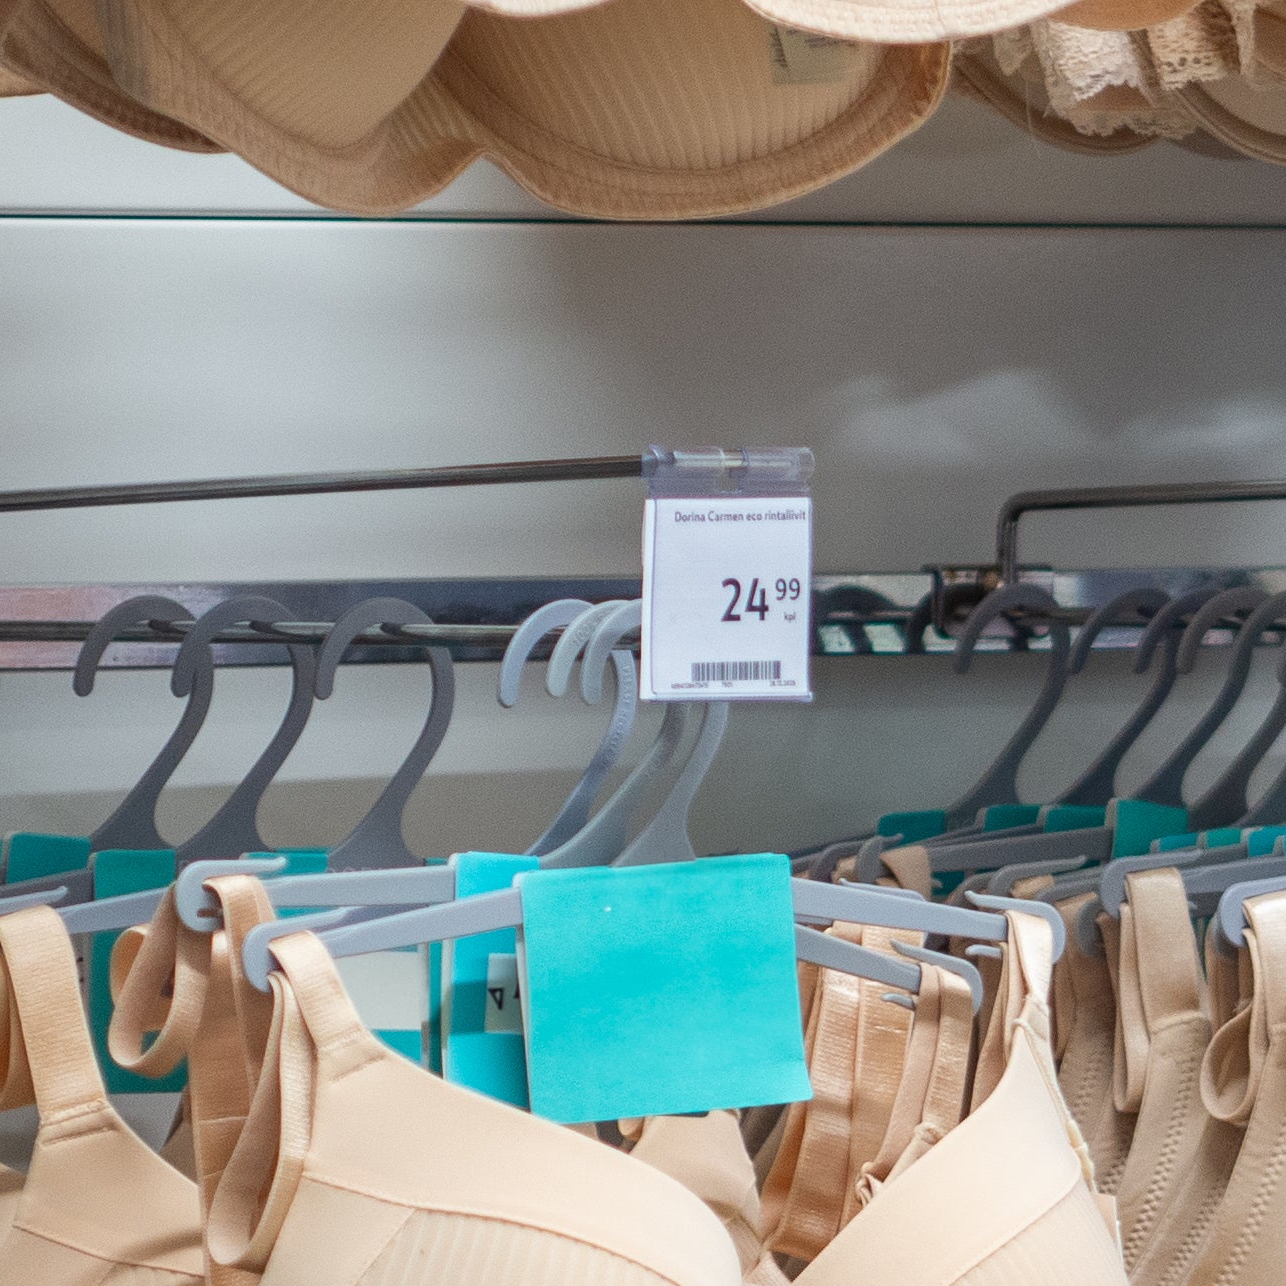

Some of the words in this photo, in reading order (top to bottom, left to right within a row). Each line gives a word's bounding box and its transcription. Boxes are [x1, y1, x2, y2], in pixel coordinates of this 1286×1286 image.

[674, 511, 706, 523] Dorina
[707, 511, 744, 522] Carmen
[746, 513, 763, 522] eco
[720, 577, 769, 622] 24
[775, 578, 801, 600] 99
[784, 612, 796, 623] kpl
